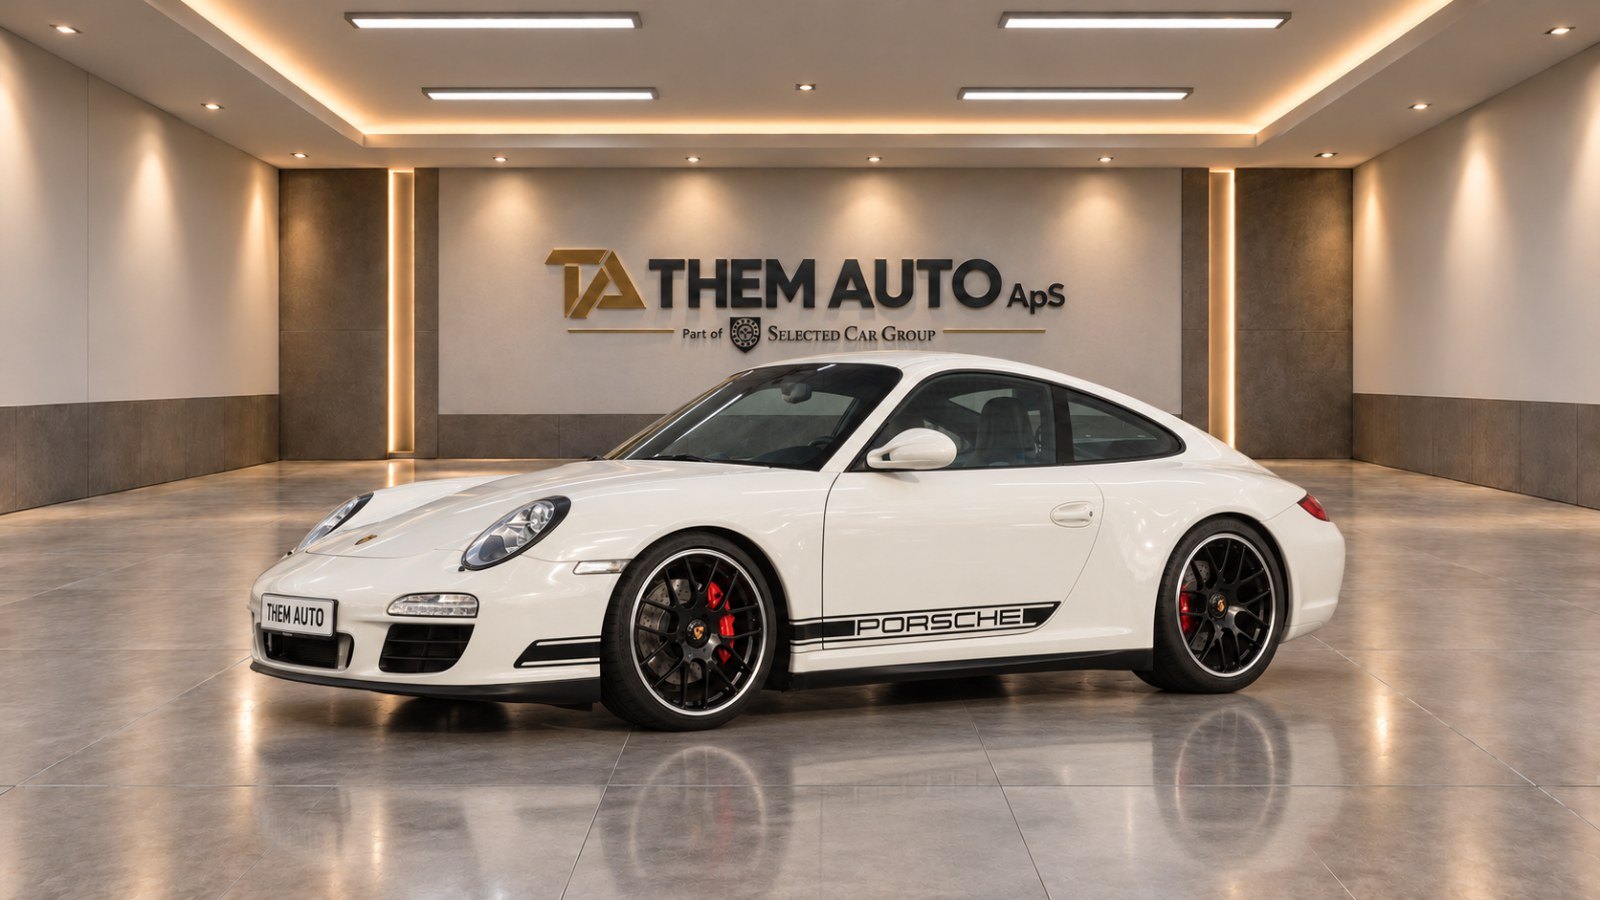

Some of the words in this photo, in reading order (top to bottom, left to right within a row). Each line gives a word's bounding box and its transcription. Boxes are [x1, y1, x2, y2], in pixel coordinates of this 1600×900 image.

[648, 258, 815, 309] THEM
[828, 258, 1003, 310] AUTO
[1007, 282, 1066, 315] ApS
[682, 328, 707, 340] Part
[710, 328, 723, 340] of
[267, 603, 291, 624] THEM
[293, 606, 324, 627] AUTO
[857, 608, 1021, 636] PORSCHE
